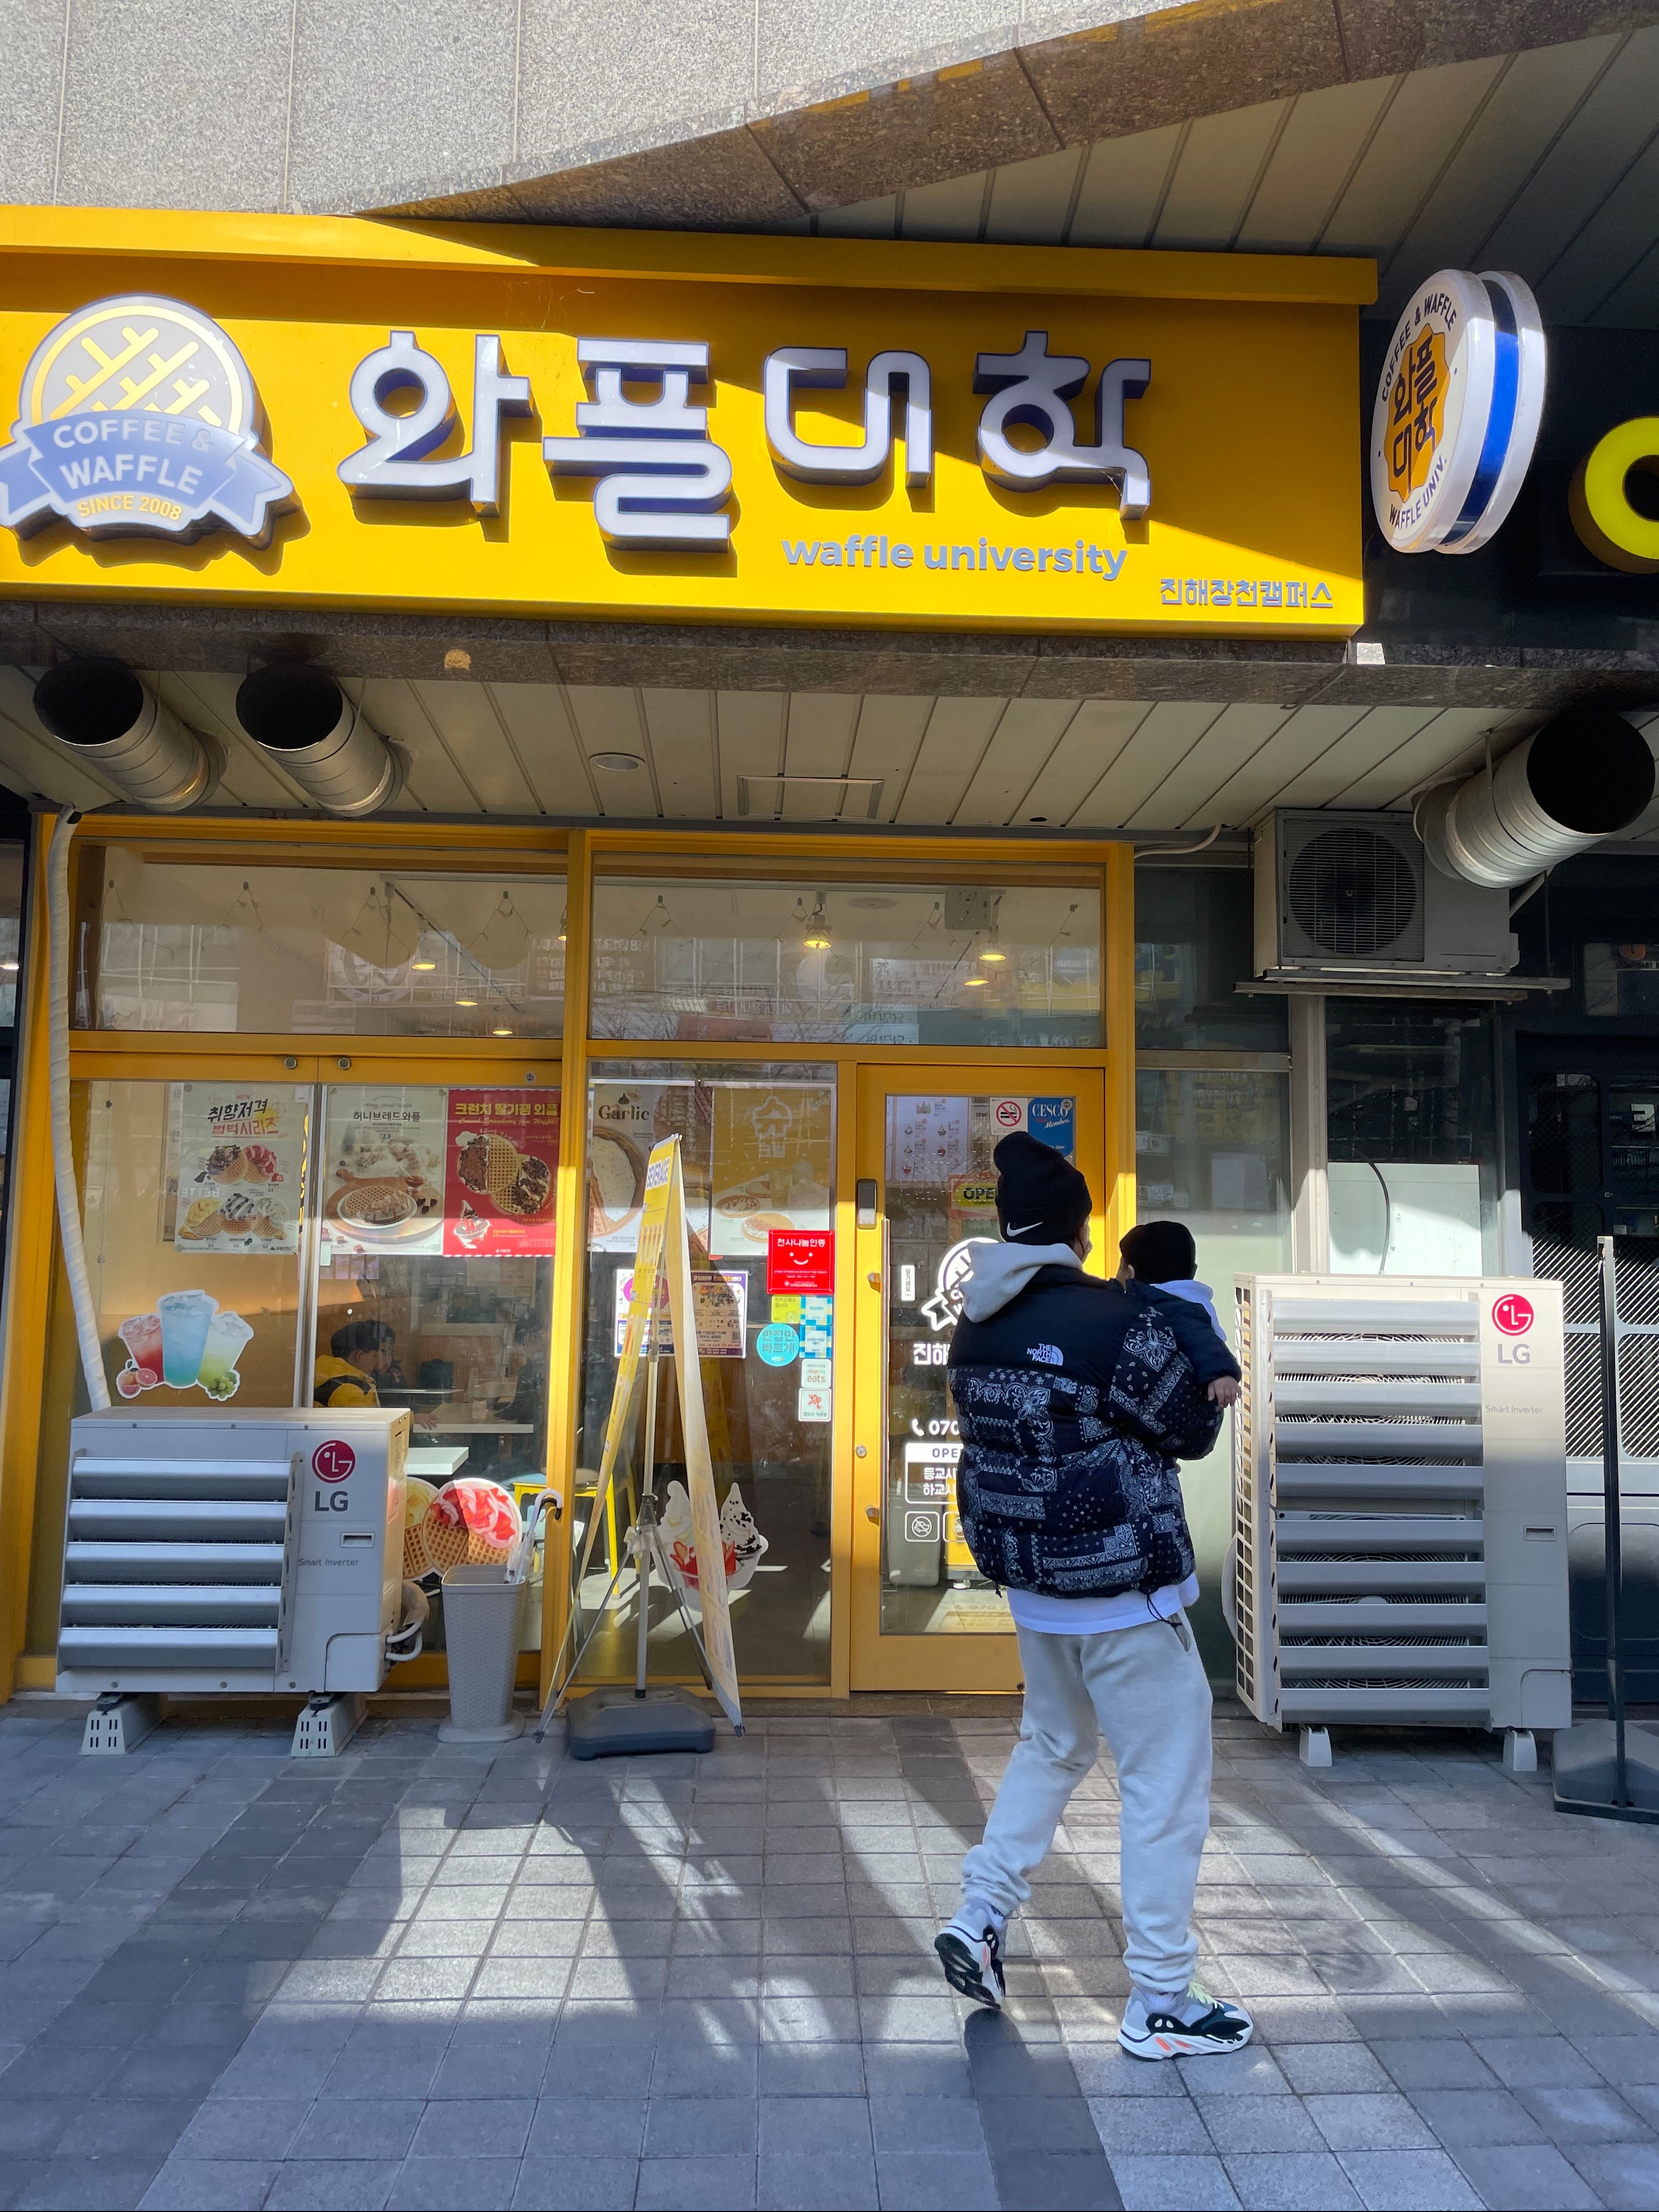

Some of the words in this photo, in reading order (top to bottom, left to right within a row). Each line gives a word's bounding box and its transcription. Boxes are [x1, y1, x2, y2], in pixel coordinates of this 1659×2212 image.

[1381, 324, 1412, 403] COFFEE
[1424, 291, 1459, 334] WAFFLE
[1393, 333, 1439, 426] 와플
[53, 419, 185, 449] COFFEE
[191, 428, 212, 452] &
[336, 330, 1151, 548] 와플대학
[1392, 396, 1437, 494] 대학
[59, 453, 204, 495] WAFFLE
[77, 494, 134, 517] SINCE
[138, 495, 182, 521] 2008
[1390, 503, 1422, 531] WAFFLE
[782, 534, 913, 569] waffle
[924, 537, 1128, 582] university
[1160, 577, 1334, 609] 진해장천캠퍼스
[207, 1098, 269, 1123] 취향저격
[353, 1110, 421, 1122] 허니브레드와플
[455, 1103, 492, 1115] 크런치
[533, 1103, 558, 1115] 와플
[598, 1103, 650, 1121] Garlic
[1032, 1103, 1069, 1117] CESCO
[212, 1117, 279, 1135] 범벅시리즈
[1044, 1118, 1070, 1129] Members
[759, 1144, 786, 1158] 크림
[646, 1156, 670, 1190] BEVERAGE
[963, 1188, 997, 1199] OPE
[777, 1238, 826, 1248] 천사나눔인증
[762, 1329, 796, 1342] 한집만
[762, 1342, 795, 1355] 빠르게
[1026, 1347, 1052, 1357] NORTH
[1039, 1343, 1052, 1351] THE
[1497, 1343, 1531, 1364] LG
[1032, 1355, 1051, 1363] FACE
[807, 1374, 826, 1383] eats
[1486, 1405, 1510, 1413] Smart
[1511, 1406, 1543, 1414] Inverter
[932, 1447, 962, 1458] OPE
[923, 1468, 958, 1481] 등교시
[923, 1483, 957, 1496] 하교시
[314, 1491, 348, 1512] LG
[298, 1558, 322, 1566] Smart
[325, 1559, 359, 1567] Inverter
